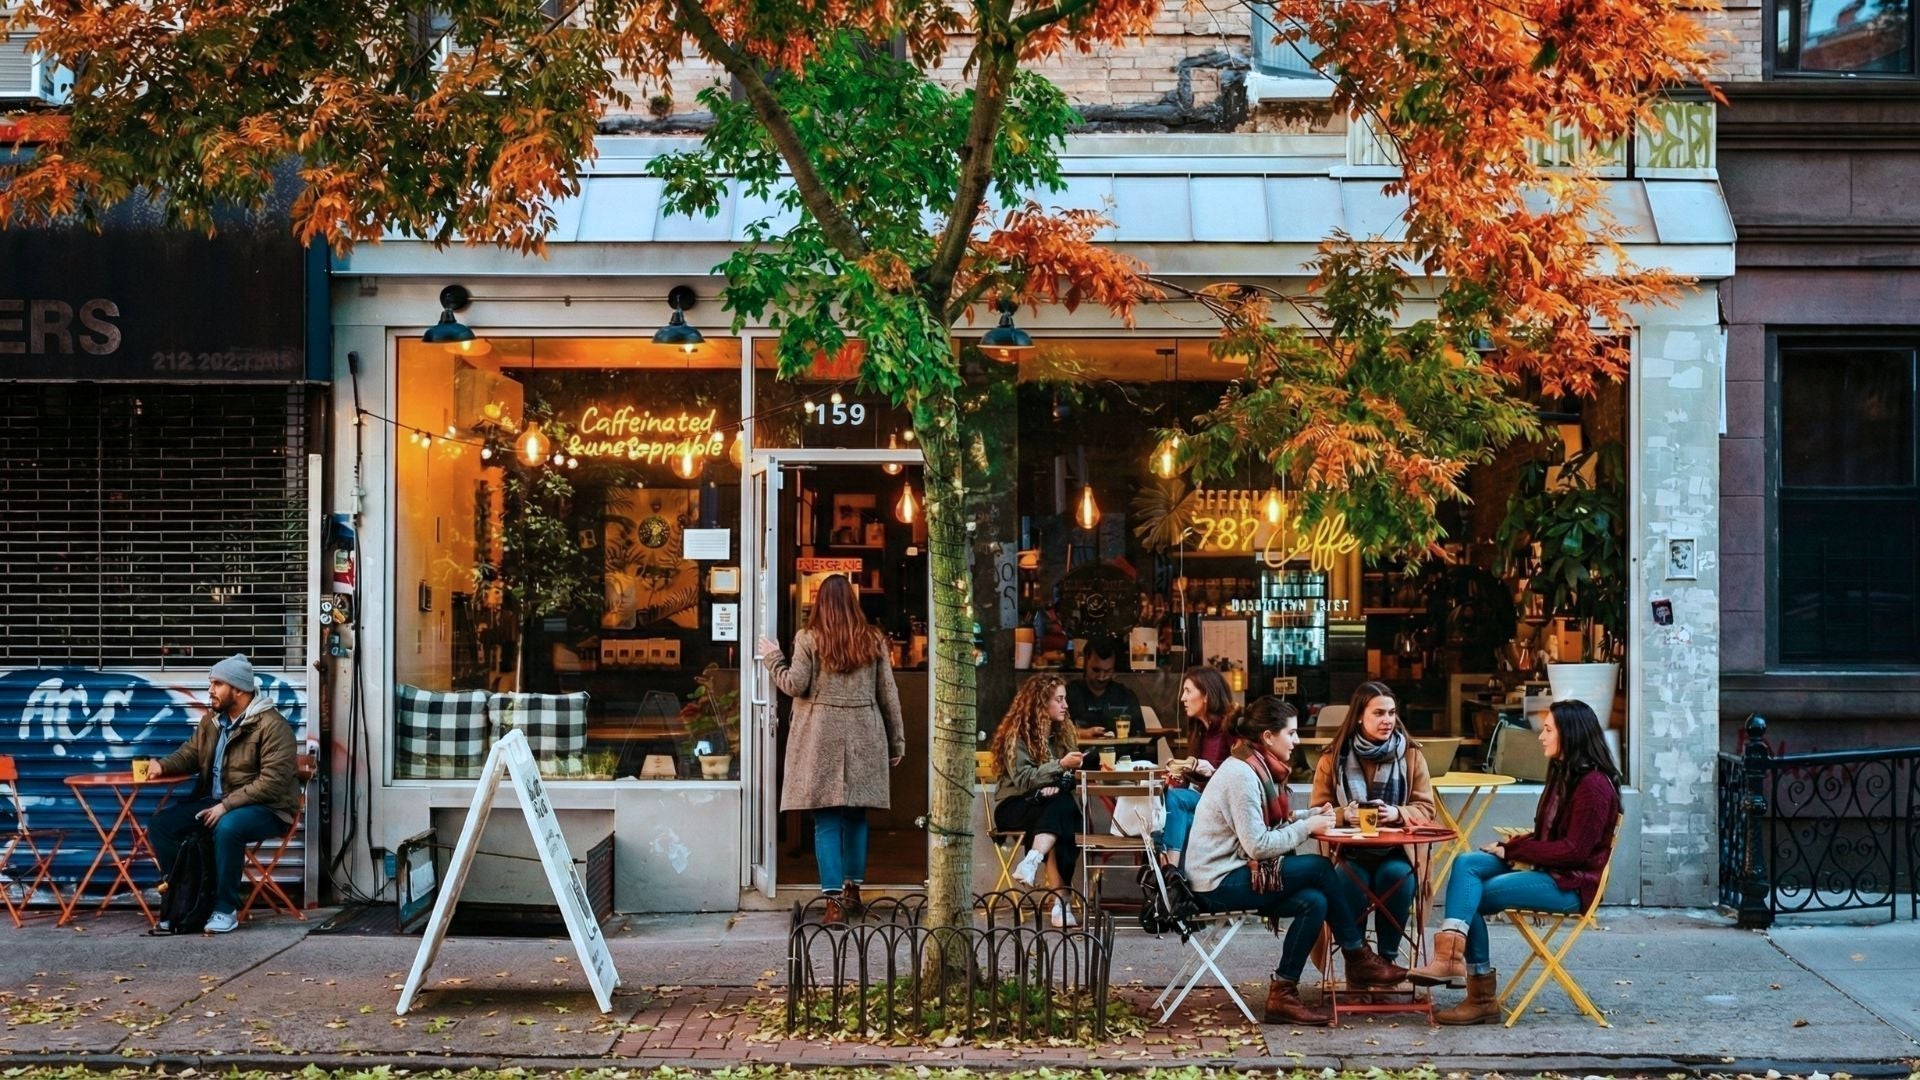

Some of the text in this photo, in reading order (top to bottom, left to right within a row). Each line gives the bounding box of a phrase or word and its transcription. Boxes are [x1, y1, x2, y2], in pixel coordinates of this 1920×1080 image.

[580, 405, 716, 437] Caffeinated
[815, 403, 866, 426] 159
[1192, 511, 1260, 550] 787
